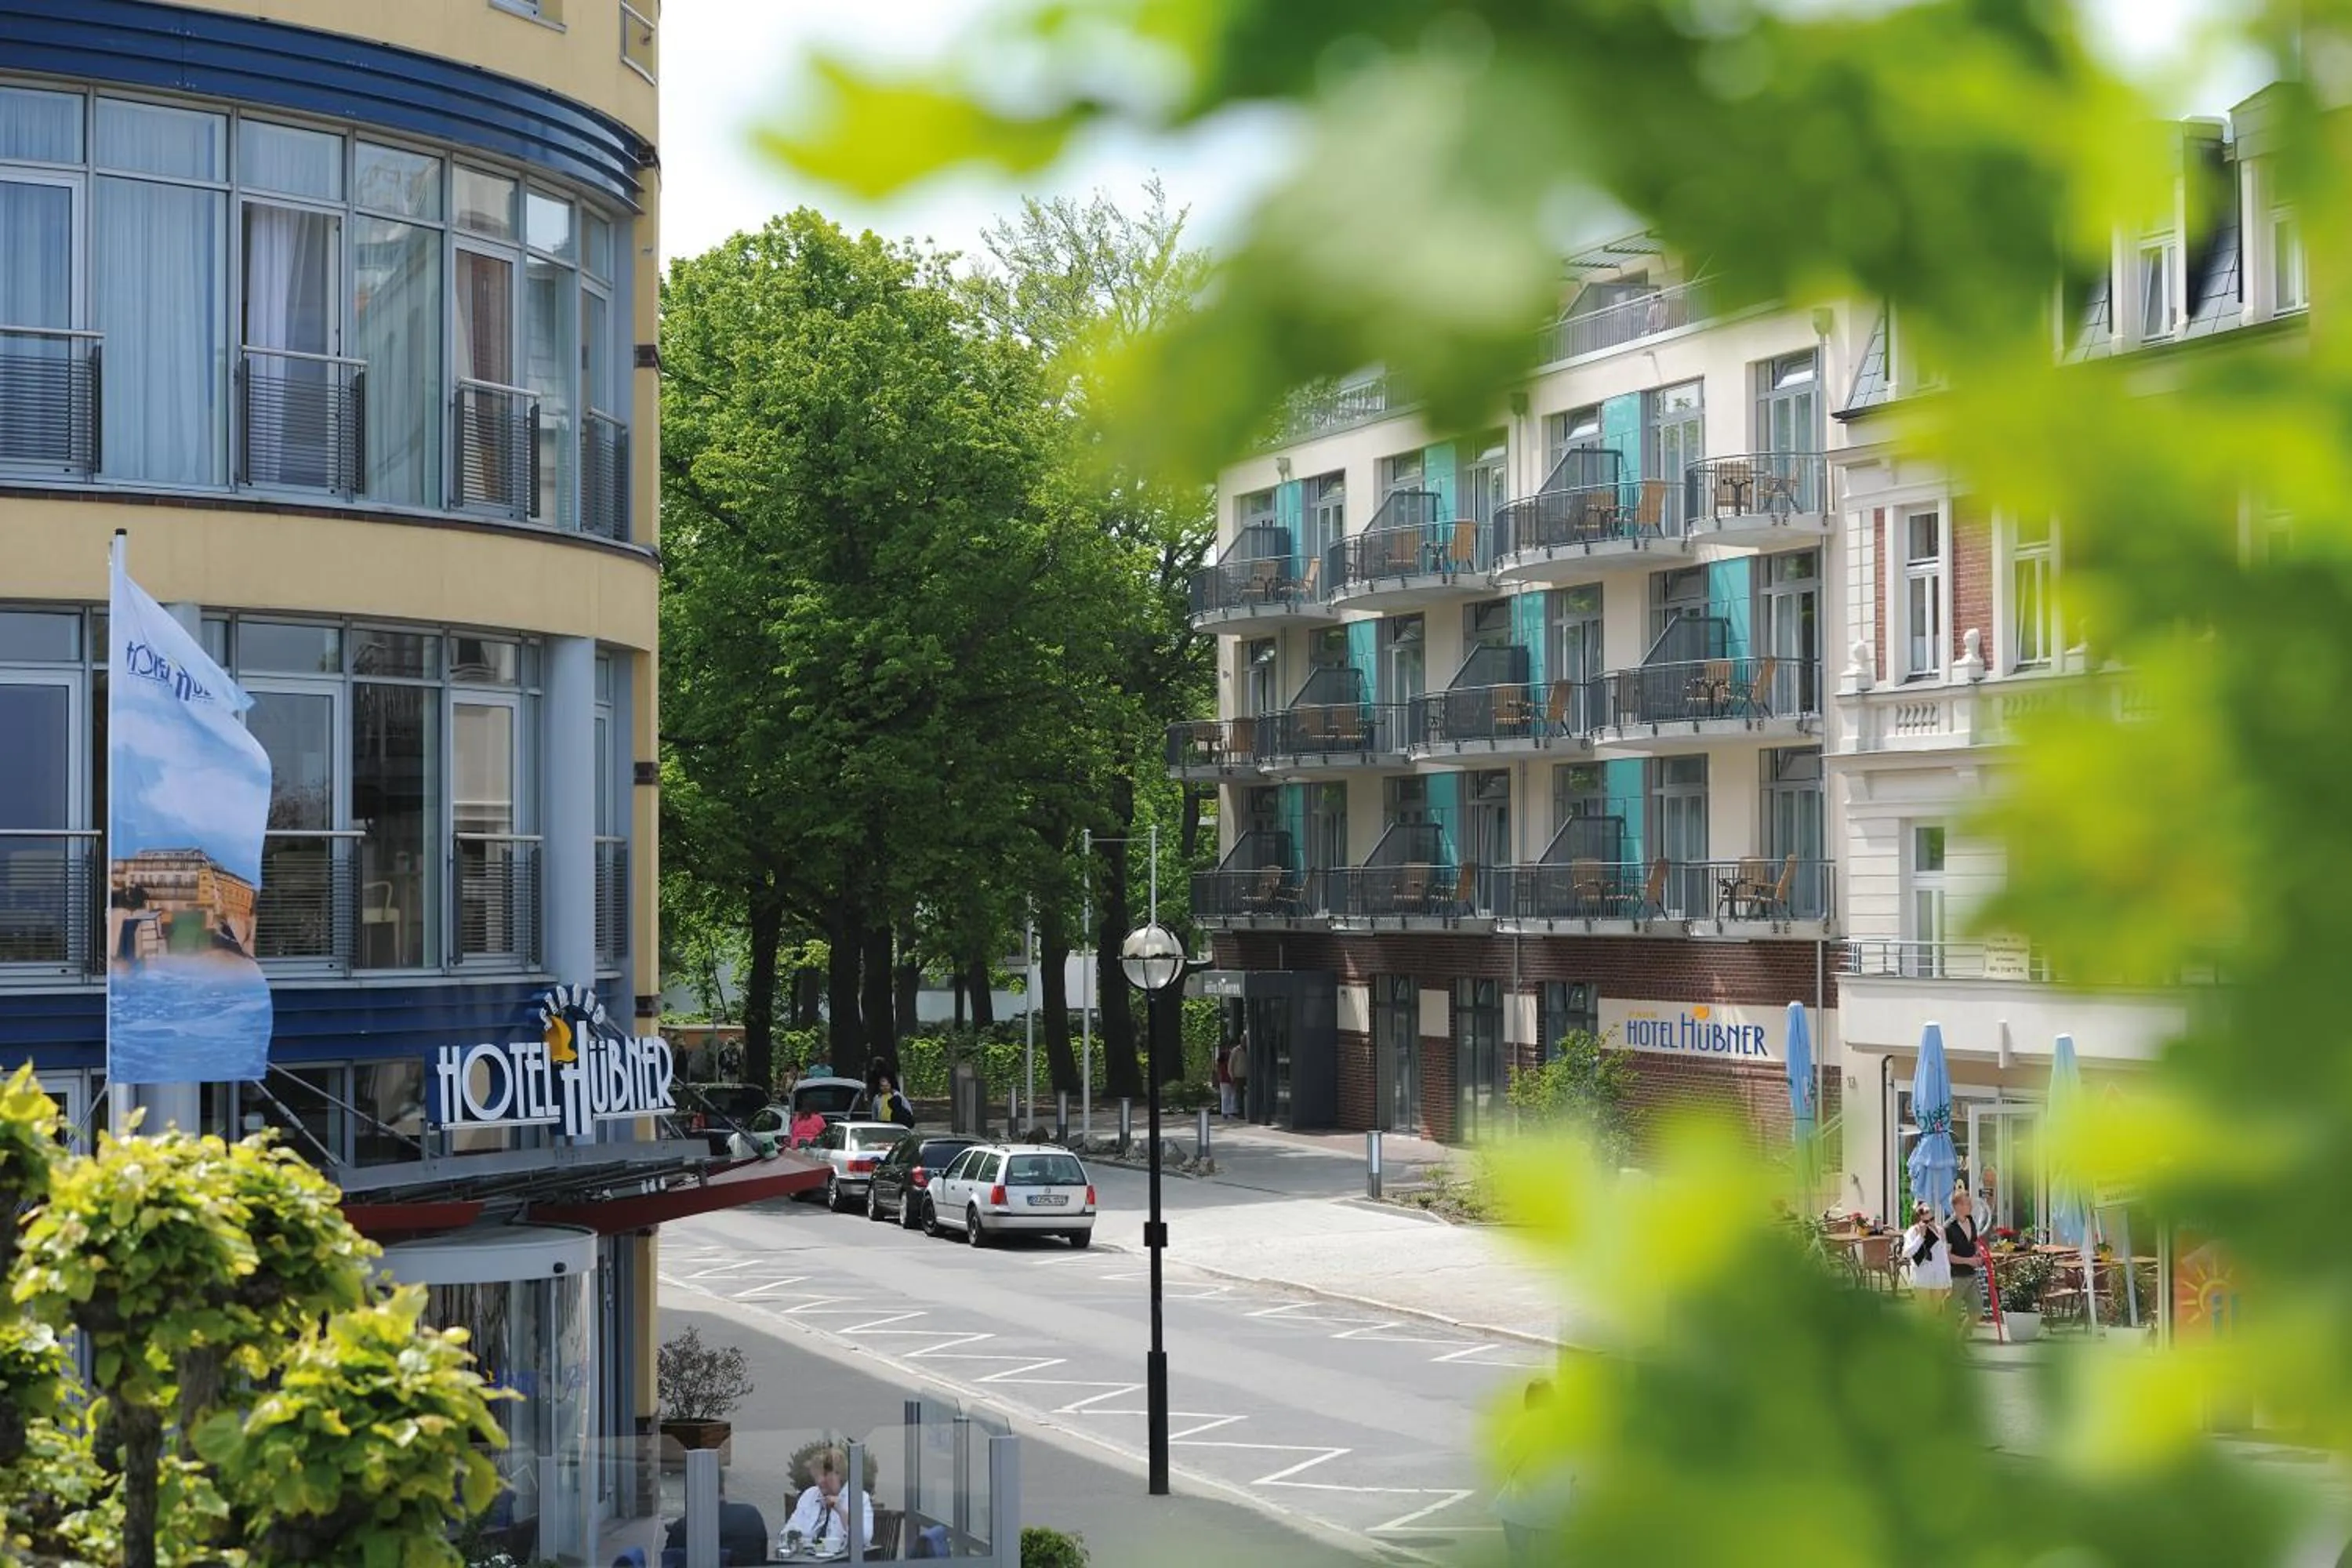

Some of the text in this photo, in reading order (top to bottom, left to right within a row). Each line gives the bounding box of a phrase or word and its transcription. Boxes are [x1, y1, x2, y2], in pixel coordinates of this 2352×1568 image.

[1627, 1012, 1768, 1056] HOTEL HÜBNER
[437, 1021, 676, 1135] HOTEL HÜBNER
